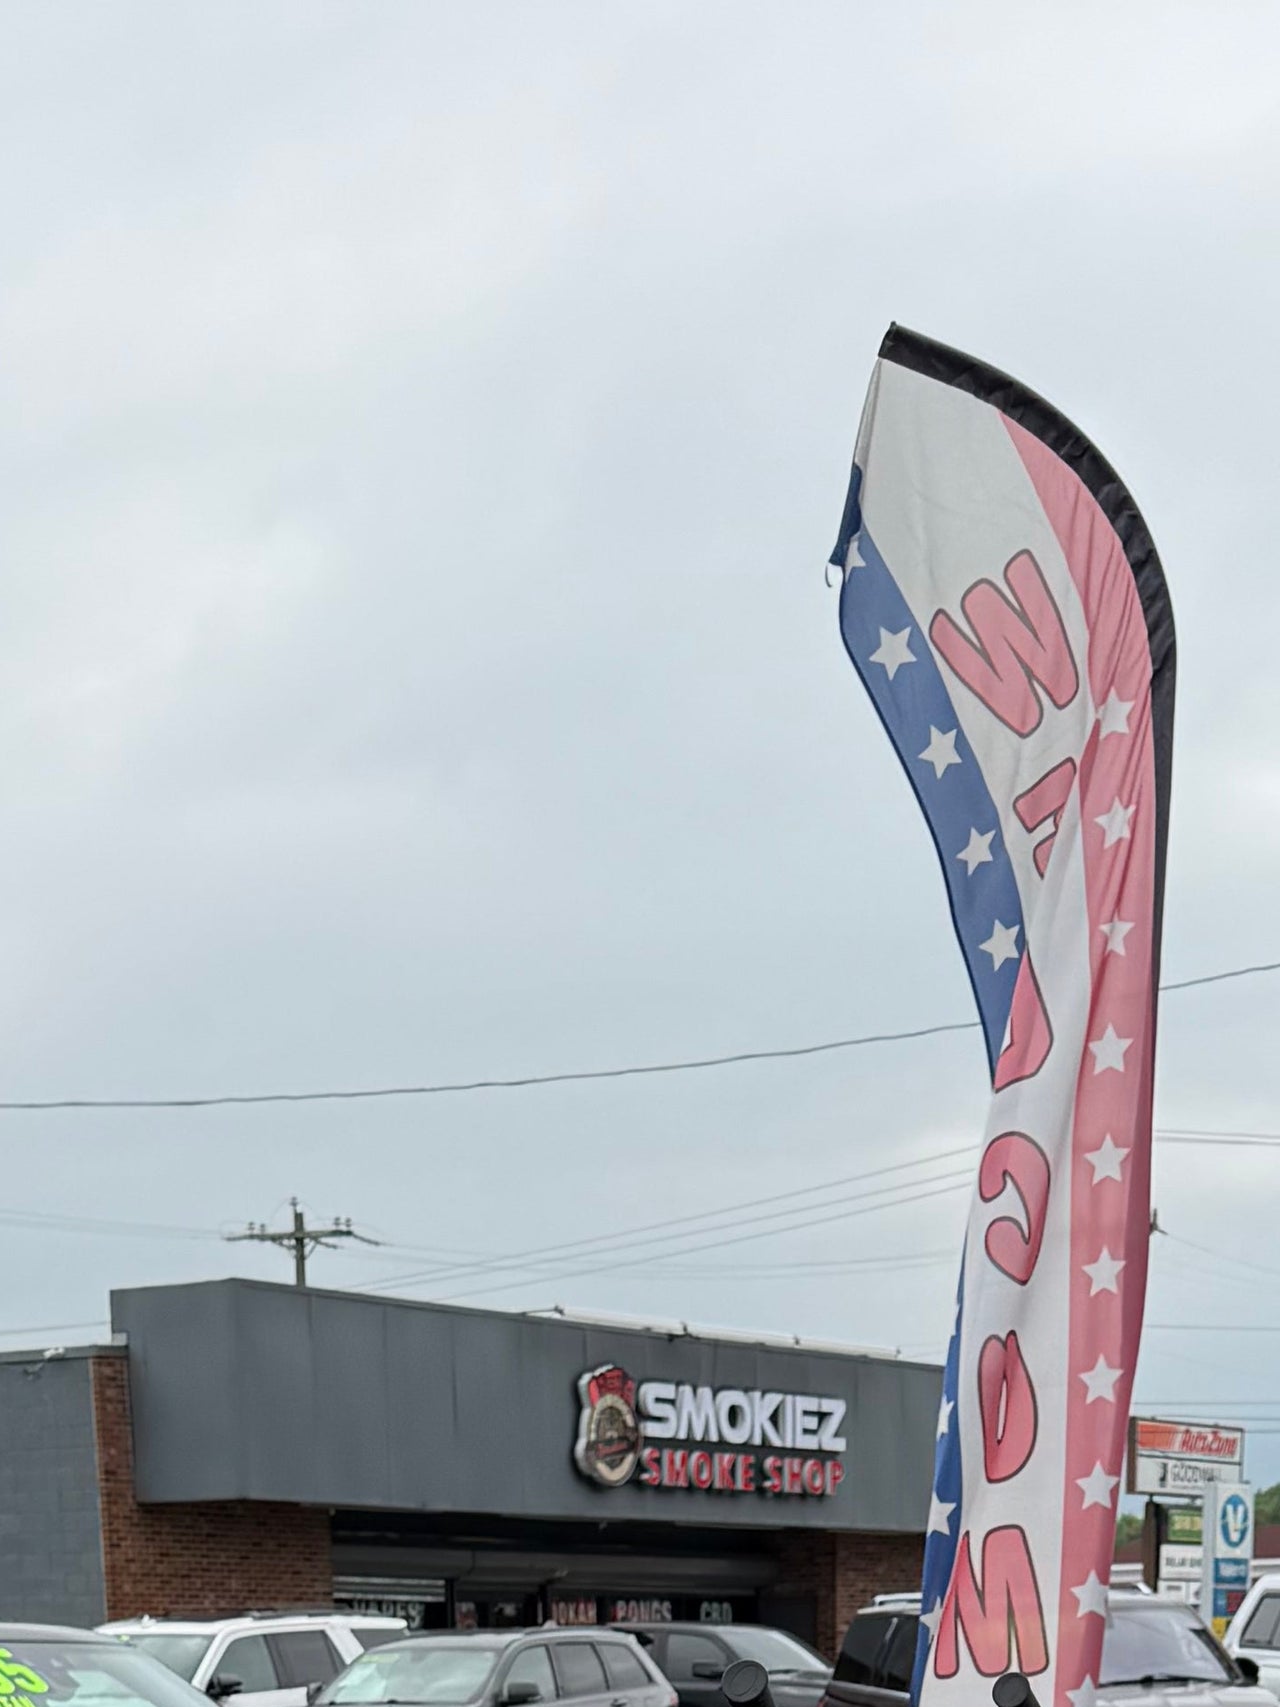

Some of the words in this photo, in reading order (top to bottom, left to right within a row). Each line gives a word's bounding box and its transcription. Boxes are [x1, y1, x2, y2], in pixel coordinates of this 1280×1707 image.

[638, 1382, 847, 1452] SMOKIEZ
[640, 1447, 755, 1492] SMOKE
[763, 1456, 845, 1496] SHOP
